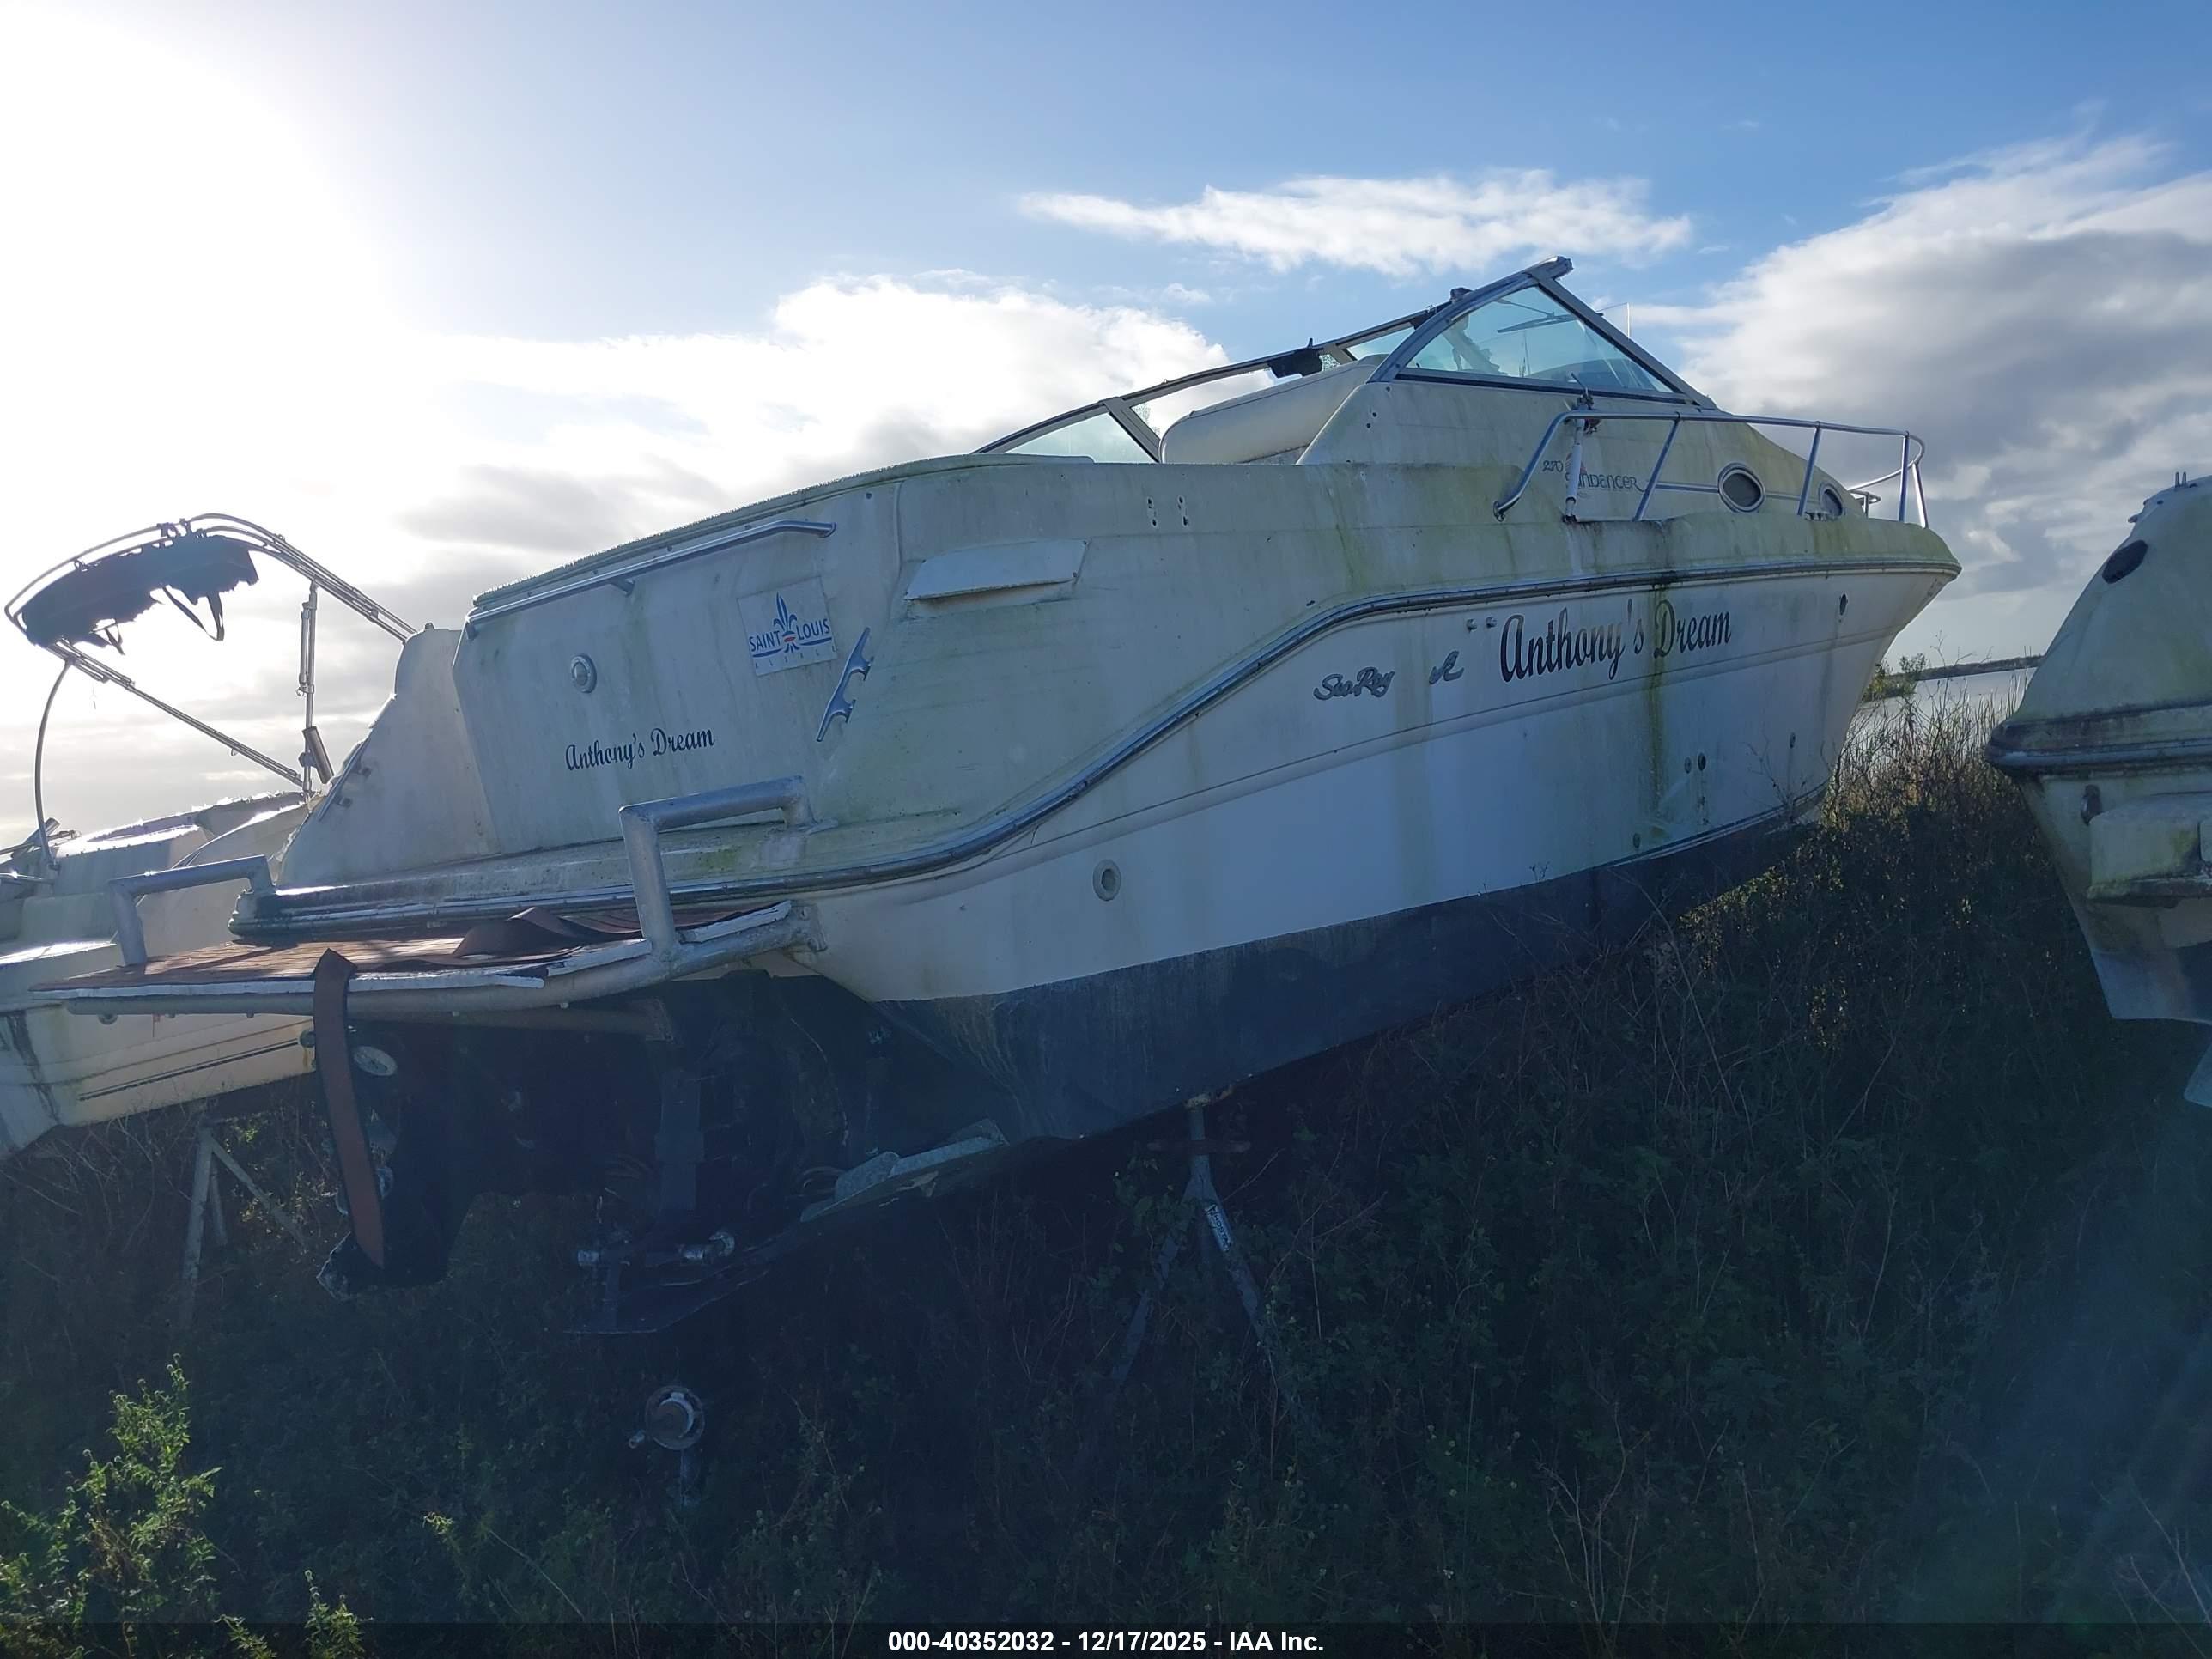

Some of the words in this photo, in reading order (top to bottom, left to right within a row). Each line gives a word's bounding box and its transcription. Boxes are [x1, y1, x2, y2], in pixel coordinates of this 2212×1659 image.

[1542, 459, 1564, 473] 270
[749, 630, 781, 652] SAINT
[796, 618, 830, 641] LOUIS
[1500, 599, 1644, 683] Anthony's
[1653, 599, 1731, 659] Dream
[565, 733, 645, 771] Anthony's
[650, 727, 715, 757] Dream
